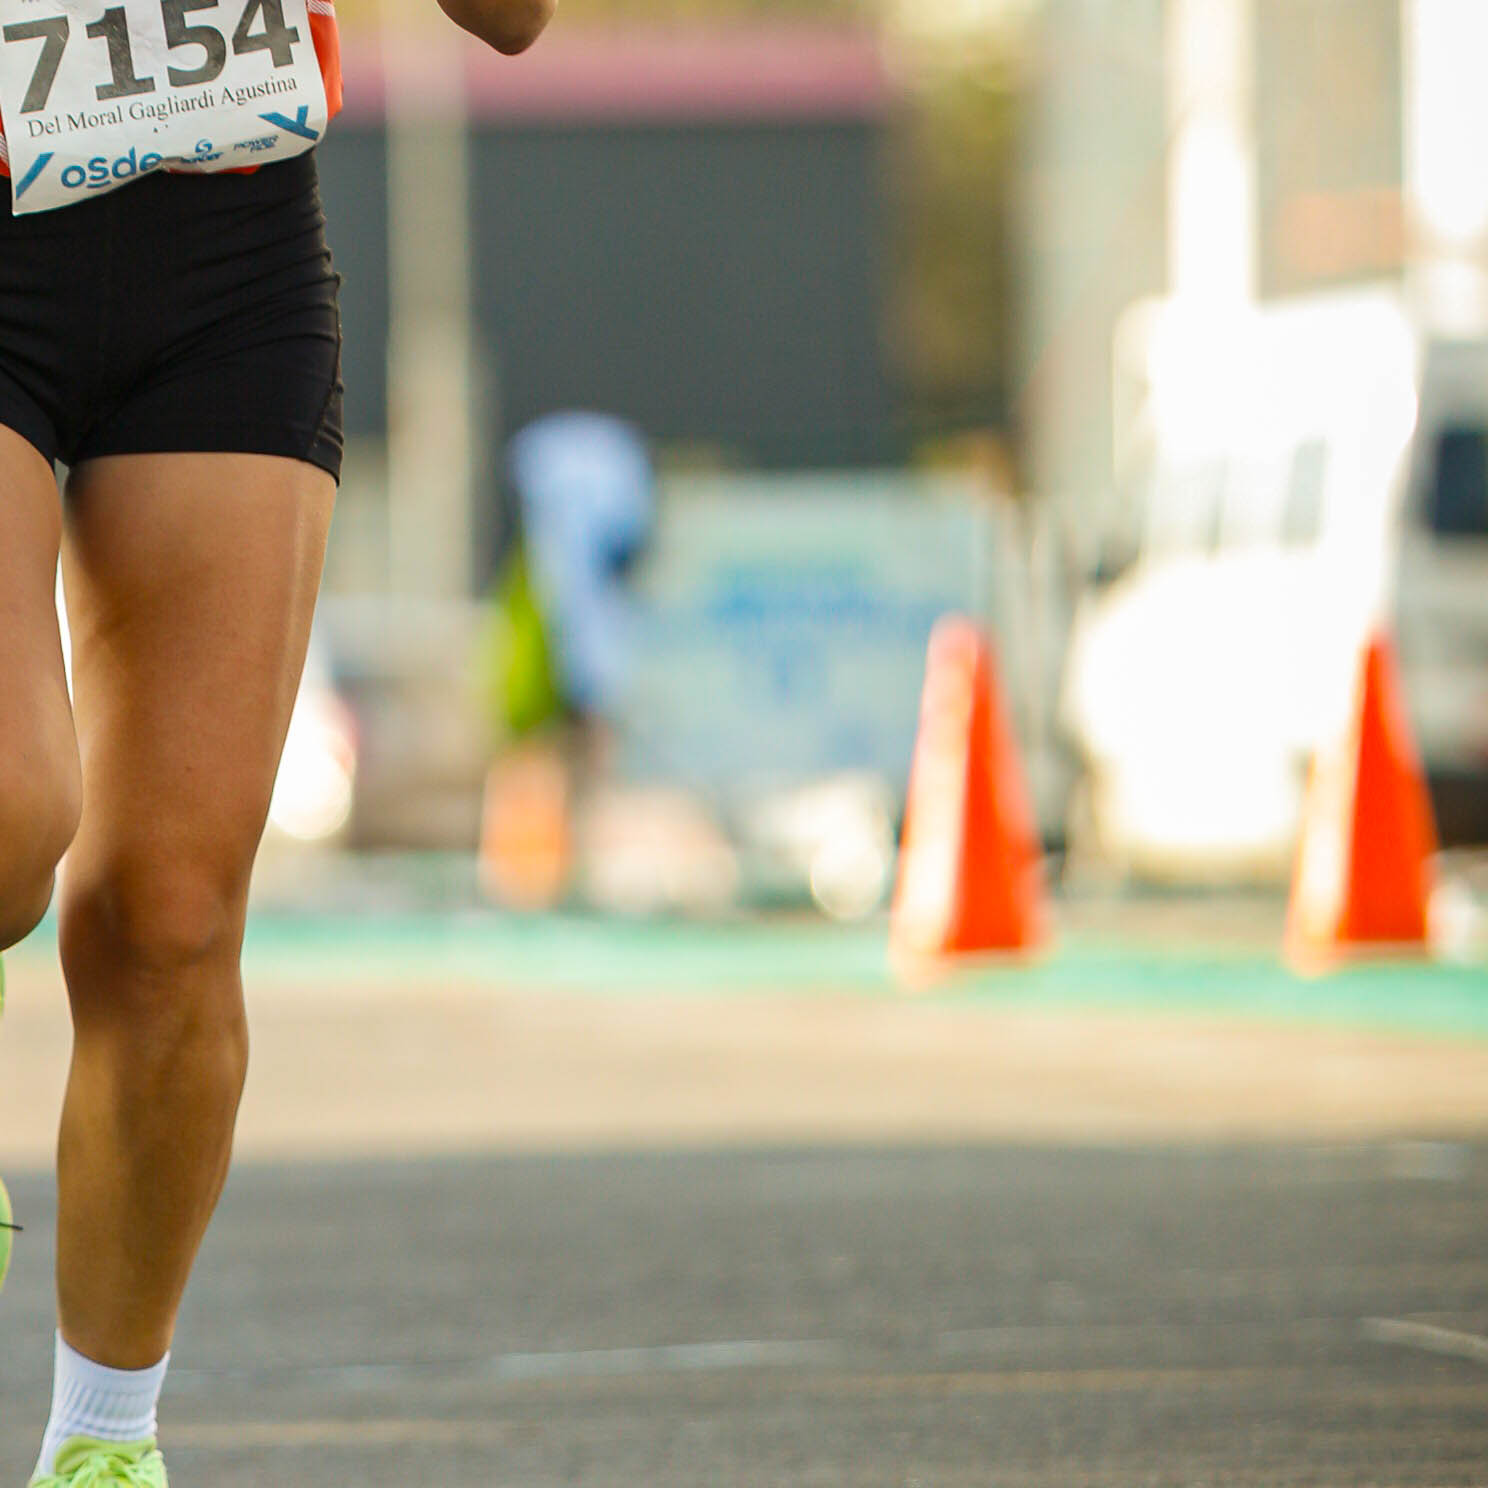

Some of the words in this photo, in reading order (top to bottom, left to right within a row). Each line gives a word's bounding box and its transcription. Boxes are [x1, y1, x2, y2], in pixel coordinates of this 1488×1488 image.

[28, 115, 62, 138] Del
[67, 106, 124, 132] Moral
[128, 89, 216, 122] Gagliardi
[220, 76, 298, 107] Agustina
[60, 146, 163, 184] osde
